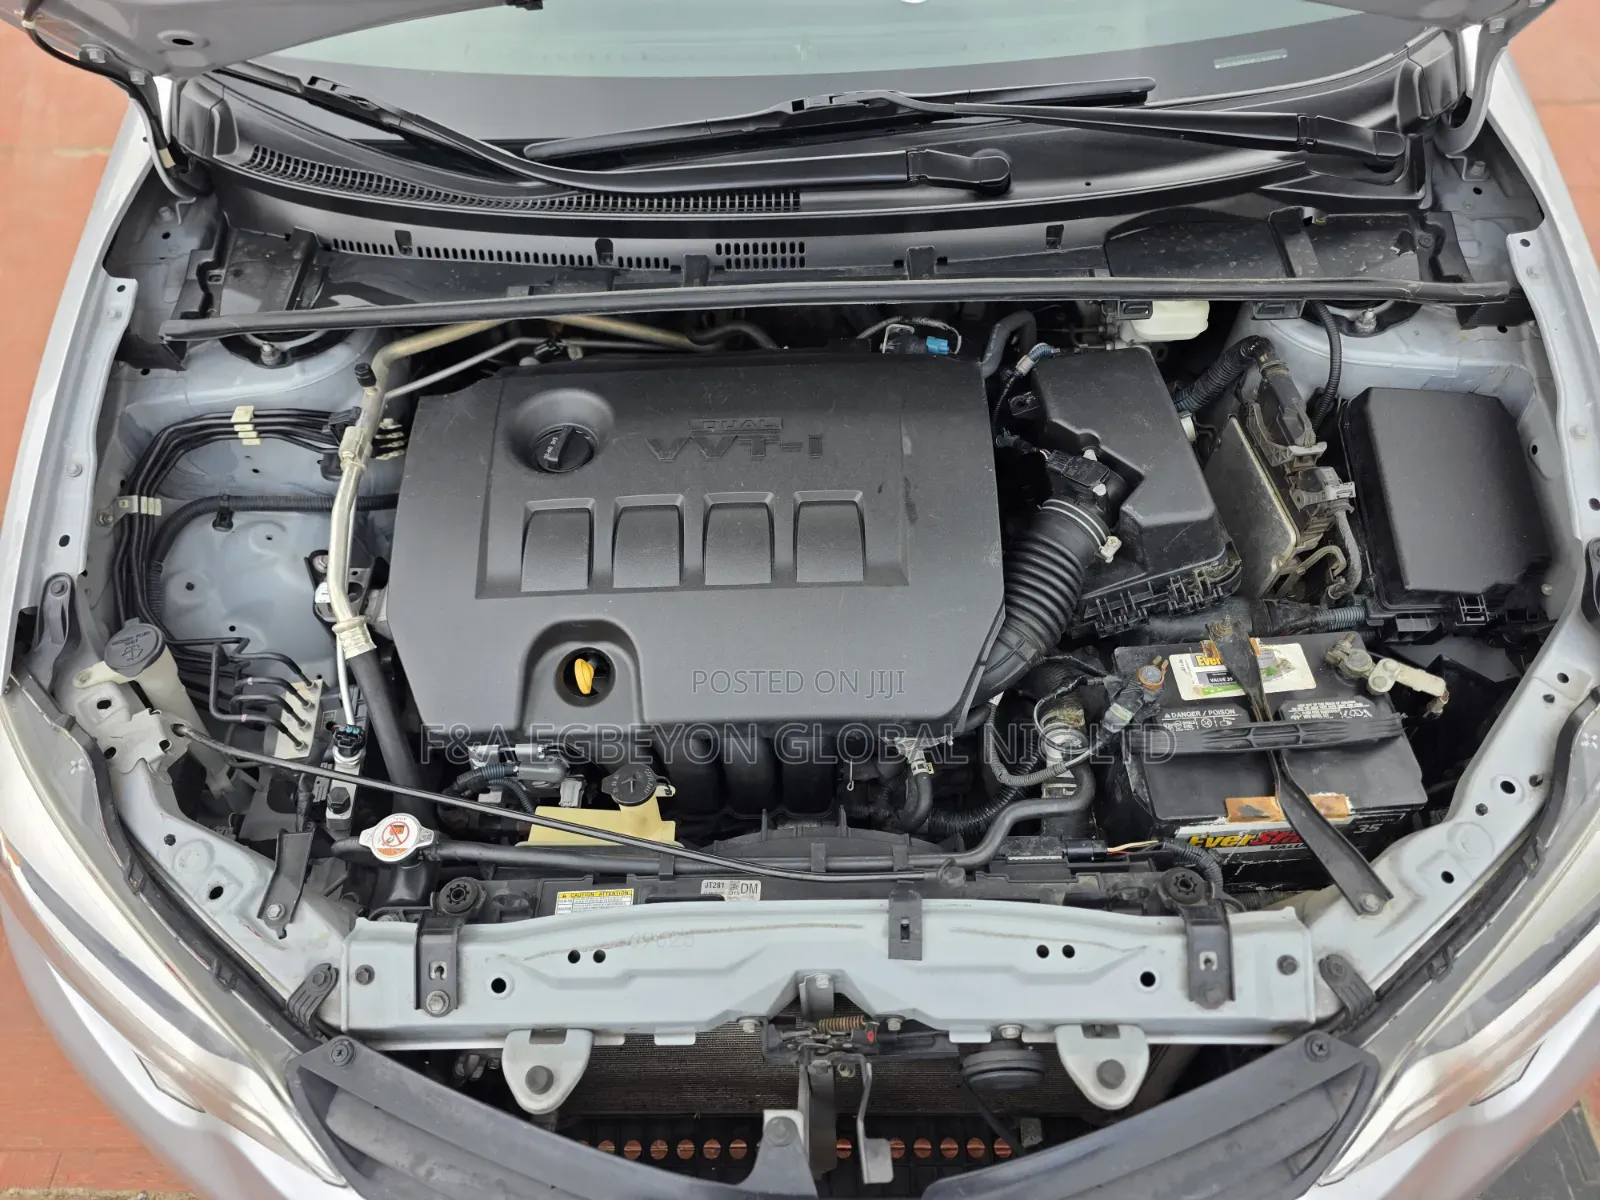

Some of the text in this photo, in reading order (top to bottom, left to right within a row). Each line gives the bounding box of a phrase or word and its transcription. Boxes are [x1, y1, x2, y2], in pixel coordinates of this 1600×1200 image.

[1171, 710, 1201, 718] DANGER
[1208, 708, 1236, 716] POISON
[1353, 823, 1384, 834] 35
[1188, 830, 1304, 849] EverSta
[740, 882, 758, 894] DM
